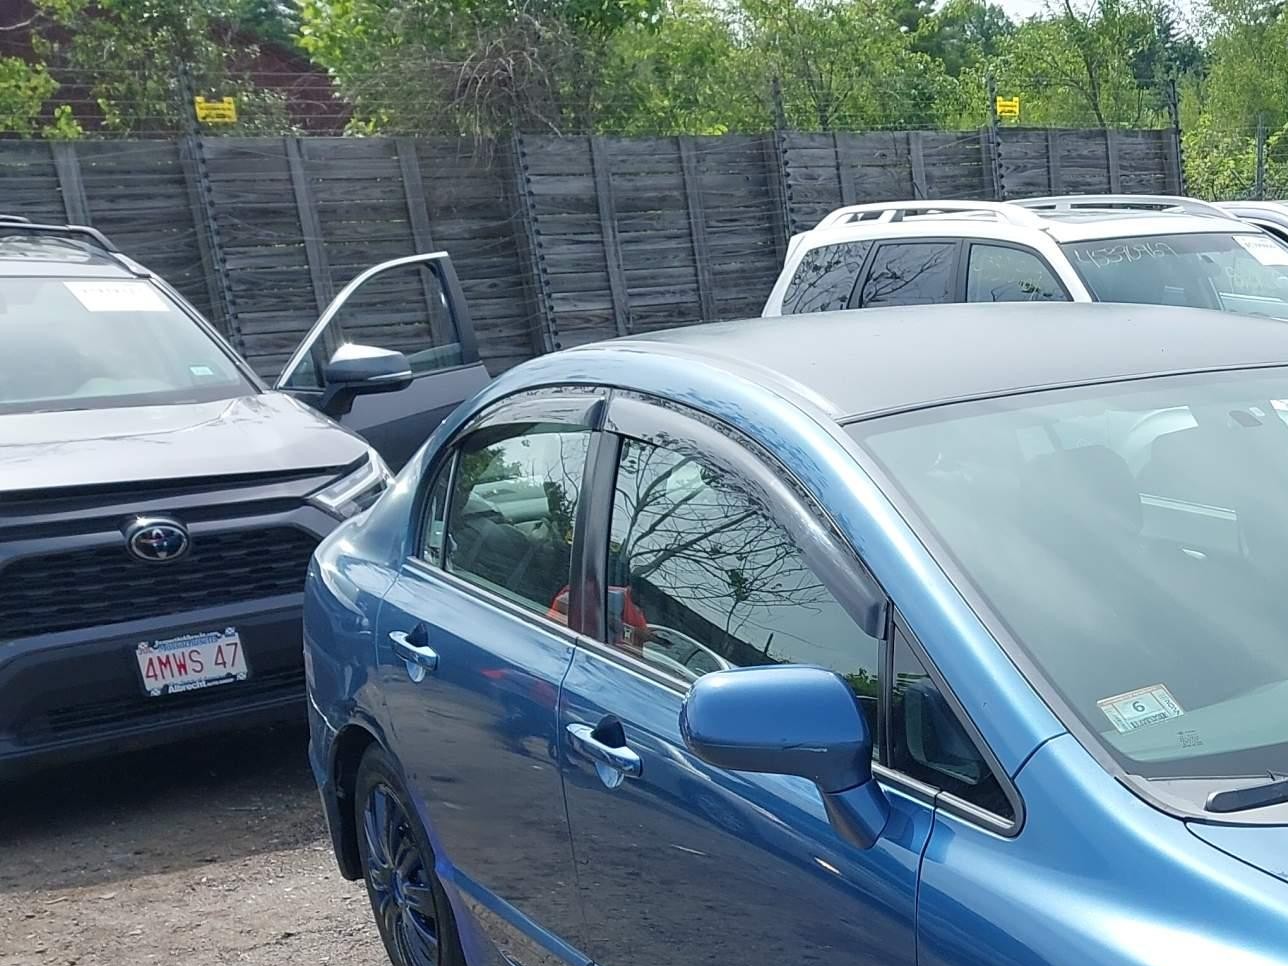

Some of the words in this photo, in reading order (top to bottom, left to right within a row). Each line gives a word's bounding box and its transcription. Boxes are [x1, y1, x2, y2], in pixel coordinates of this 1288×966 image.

[145, 649, 204, 681] 4MWS
[214, 641, 239, 669] 47
[1132, 700, 1146, 713] 6
